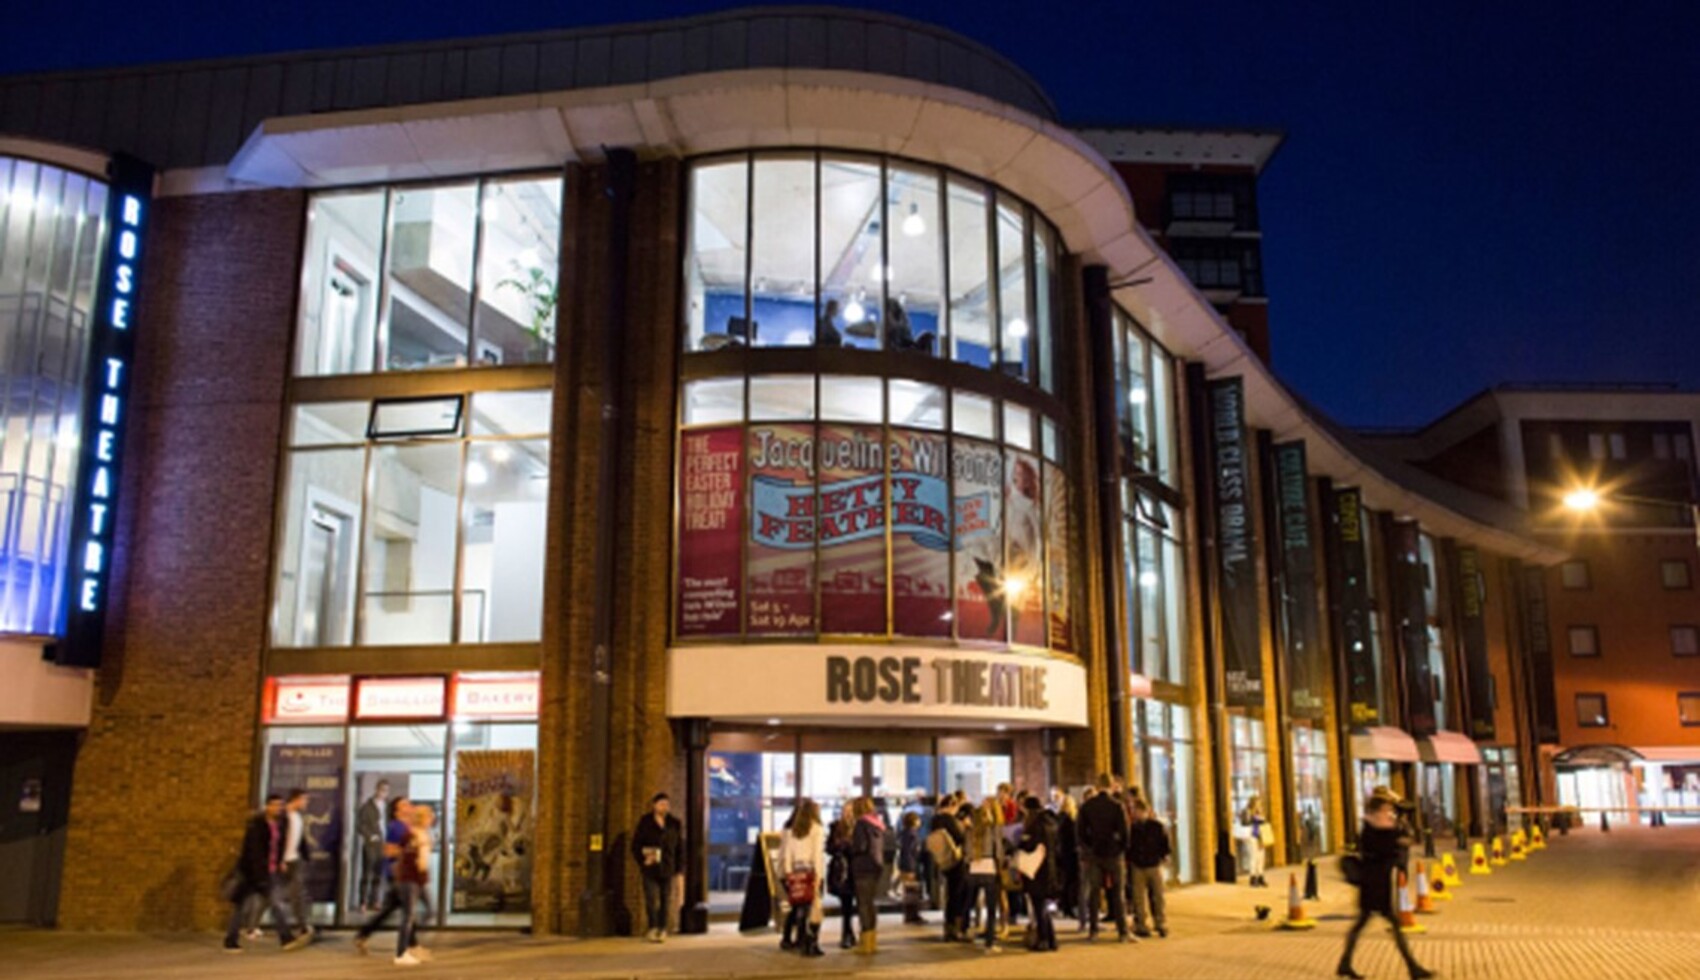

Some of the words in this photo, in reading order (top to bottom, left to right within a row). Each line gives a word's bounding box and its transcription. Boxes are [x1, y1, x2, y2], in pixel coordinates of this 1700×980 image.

[112, 196, 140, 328] ROSE
[685, 434, 710, 454] THE
[753, 430, 901, 477] Jacqueline
[685, 451, 738, 474] PERFECT
[81, 358, 124, 612] THEATRE
[685, 472, 731, 492] EASTER
[685, 490, 737, 511] HOLIDAY
[786, 477, 922, 517] HETTY
[758, 501, 949, 544] FEATHER
[750, 601, 769, 613] Sat
[750, 614, 769, 626] Sat
[825, 656, 921, 704] ROSE
[931, 657, 1048, 709] THEATRE
[467, 691, 534, 704] BAKERY
